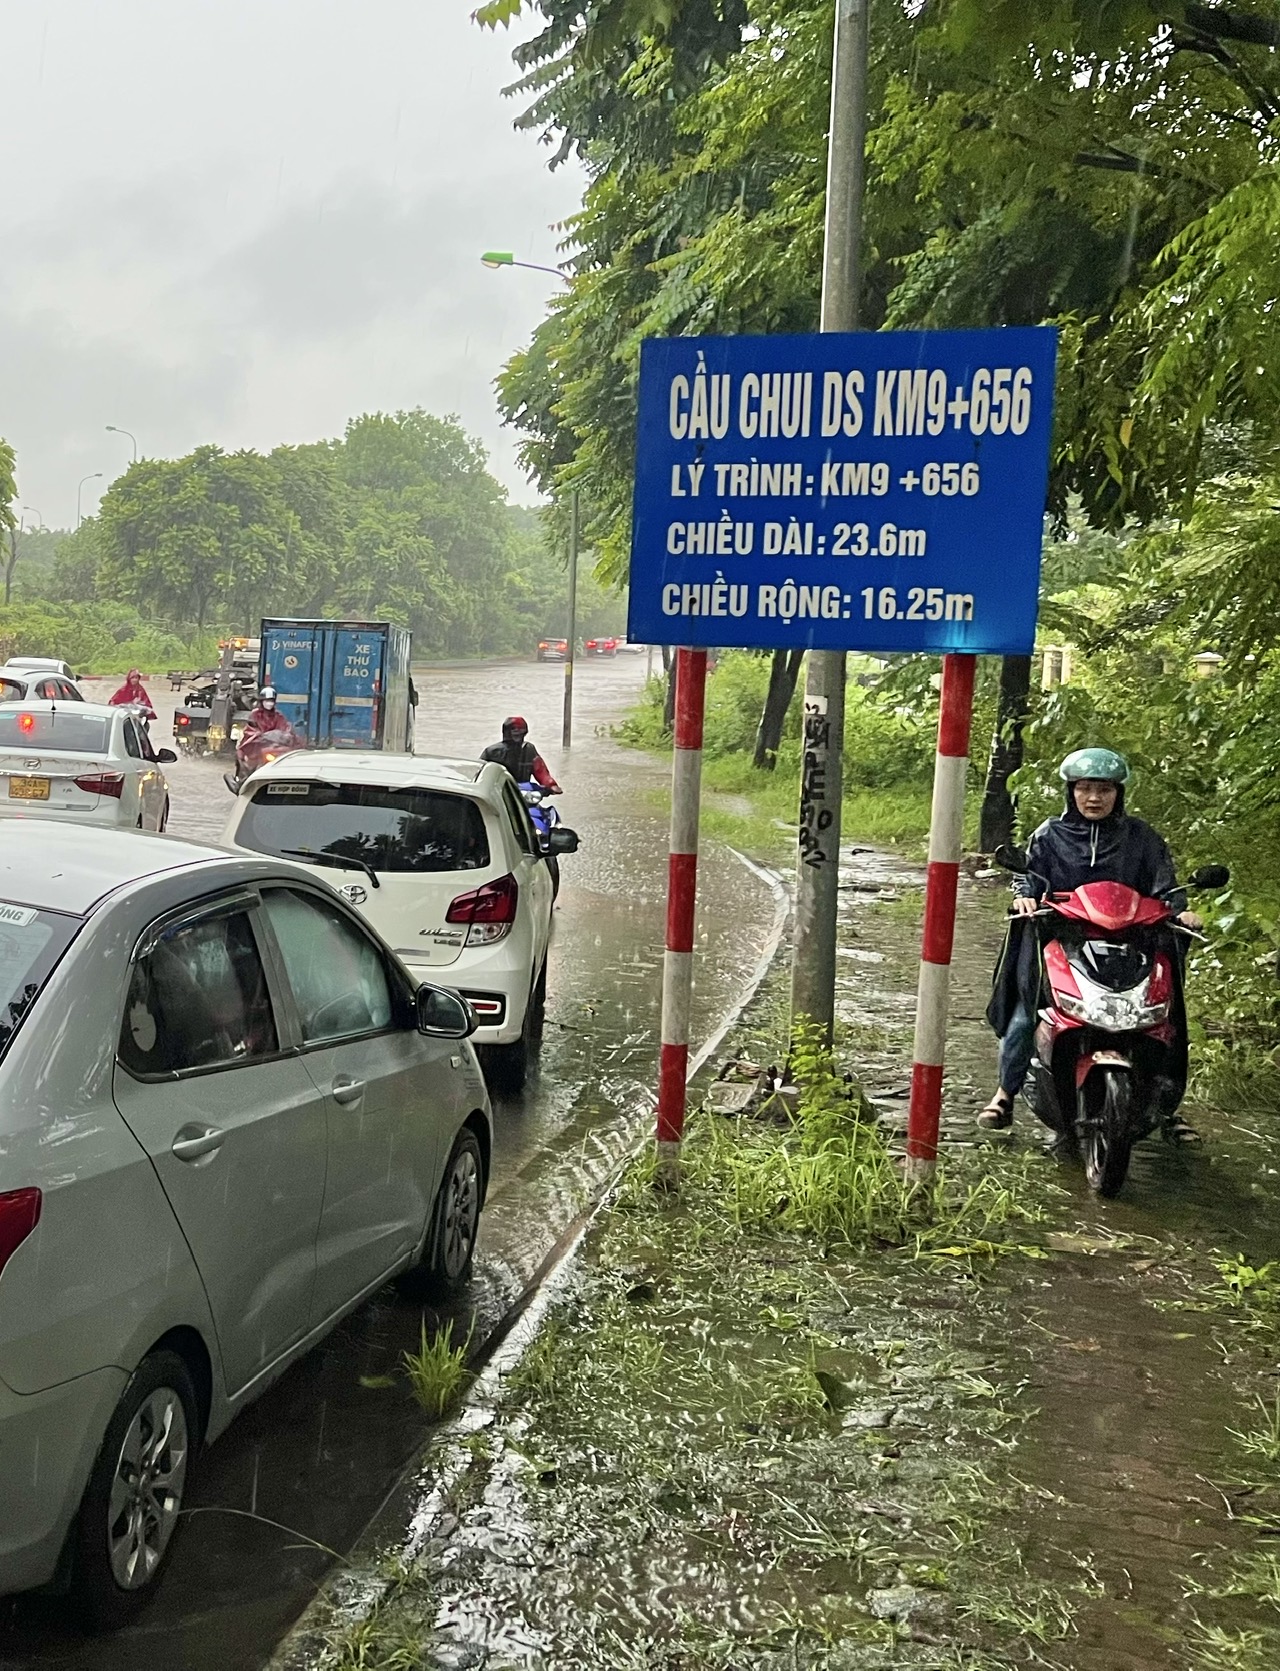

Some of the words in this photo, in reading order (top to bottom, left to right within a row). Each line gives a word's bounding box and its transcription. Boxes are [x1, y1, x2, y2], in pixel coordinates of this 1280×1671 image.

[669, 351, 730, 440] CẦU
[739, 371, 812, 439] CHUI
[821, 369, 865, 437] DS
[873, 366, 1033, 437] KM9+656
[671, 458, 704, 497] LÝ
[821, 462, 890, 497] KM9
[899, 462, 980, 496] +656
[666, 509, 754, 555] CHIỀU
[763, 516, 825, 556] DÀI:
[831, 522, 927, 557] 23.6m
[662, 570, 749, 616] CHIỀU
[757, 578, 851, 624] RỘNG:
[862, 587, 974, 621] 16.25m
[355, 644, 370, 654] XE
